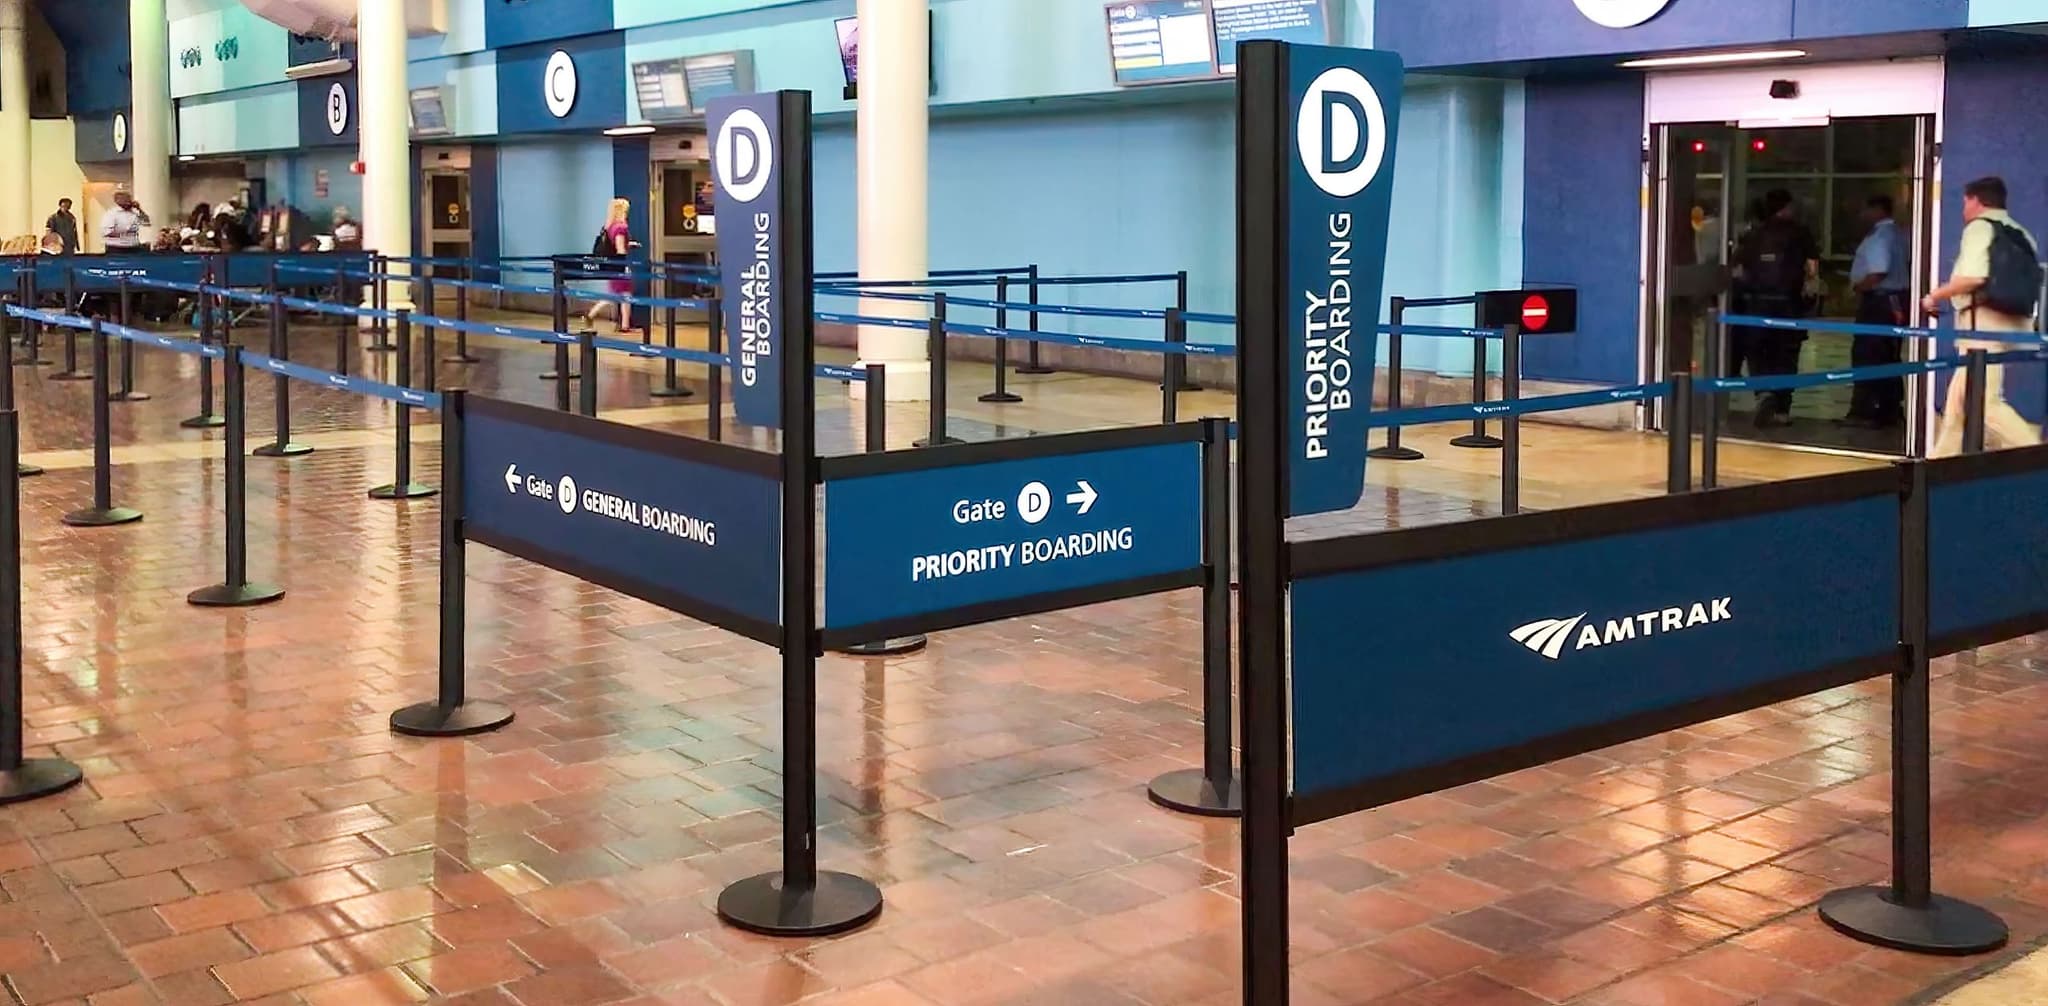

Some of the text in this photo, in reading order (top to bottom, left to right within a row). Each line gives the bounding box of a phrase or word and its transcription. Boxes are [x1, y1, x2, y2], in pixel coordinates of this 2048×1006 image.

[333, 93, 341, 124] B
[552, 65, 565, 103] C
[730, 126, 760, 186] D
[1321, 89, 1370, 175] D
[754, 212, 771, 356] BOARDING
[1329, 212, 1352, 411] BOARDING
[741, 264, 757, 387] GENERAL
[1305, 289, 1329, 460] PRIORITY
[526, 474, 716, 546] Gate D GENERAL BOARDING
[952, 492, 1042, 524] Gate D
[911, 526, 1133, 582] PRIORITY BOARDING
[1575, 596, 1732, 651] AMTRAK
